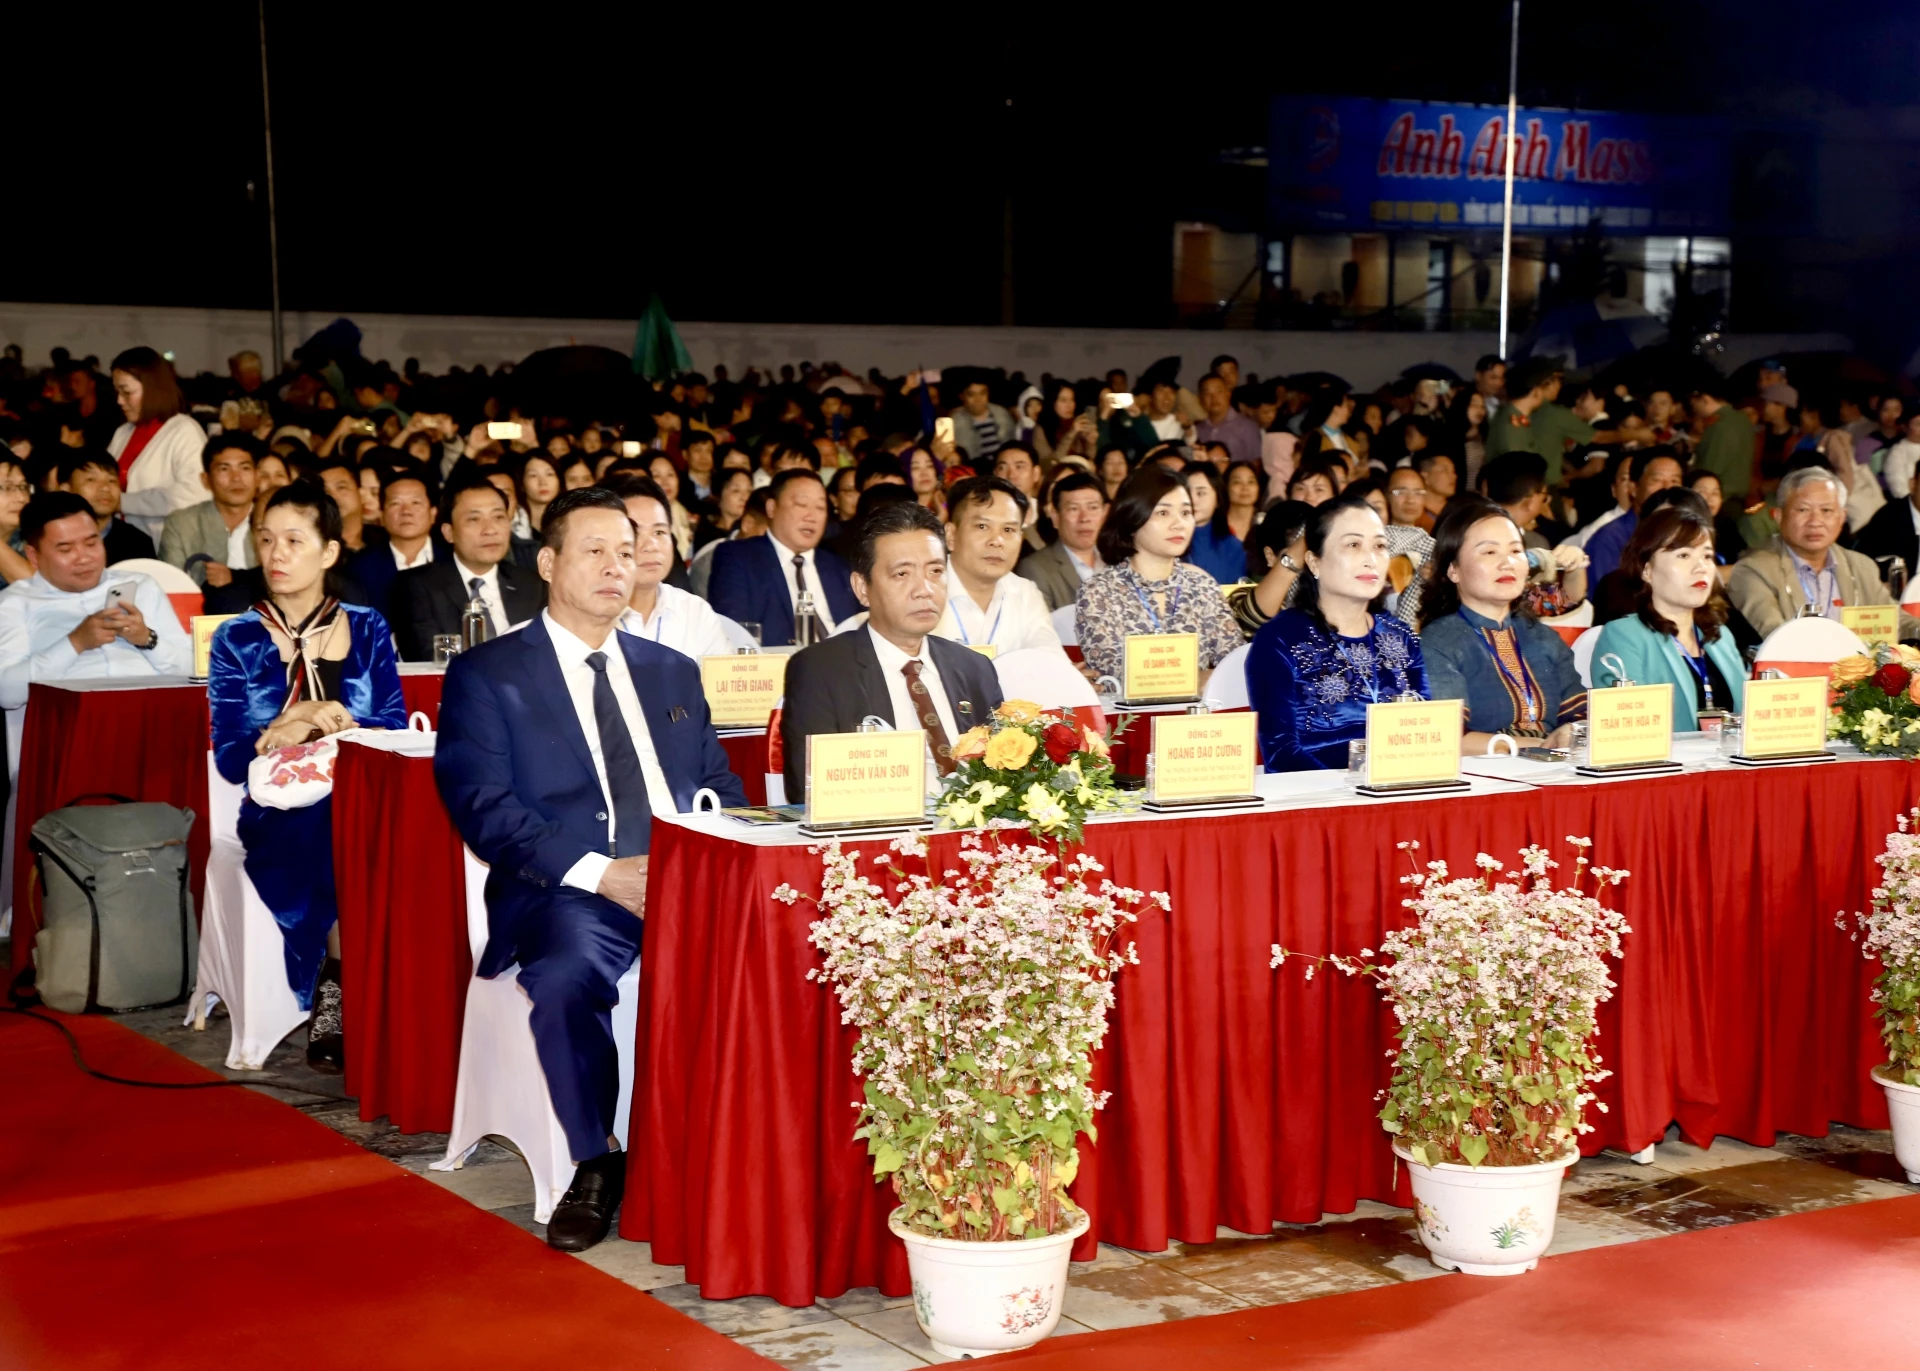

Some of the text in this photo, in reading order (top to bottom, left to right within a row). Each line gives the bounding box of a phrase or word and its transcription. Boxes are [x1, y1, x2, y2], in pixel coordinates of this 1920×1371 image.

[1377, 111, 1464, 178] Anh
[1467, 115, 1549, 182] Anh
[716, 676, 774, 695] LẠI TIẾN GIANG
[1635, 715, 1650, 727] HOA
[1414, 732, 1428, 746] THỊ
[890, 764, 910, 778] SƠN
